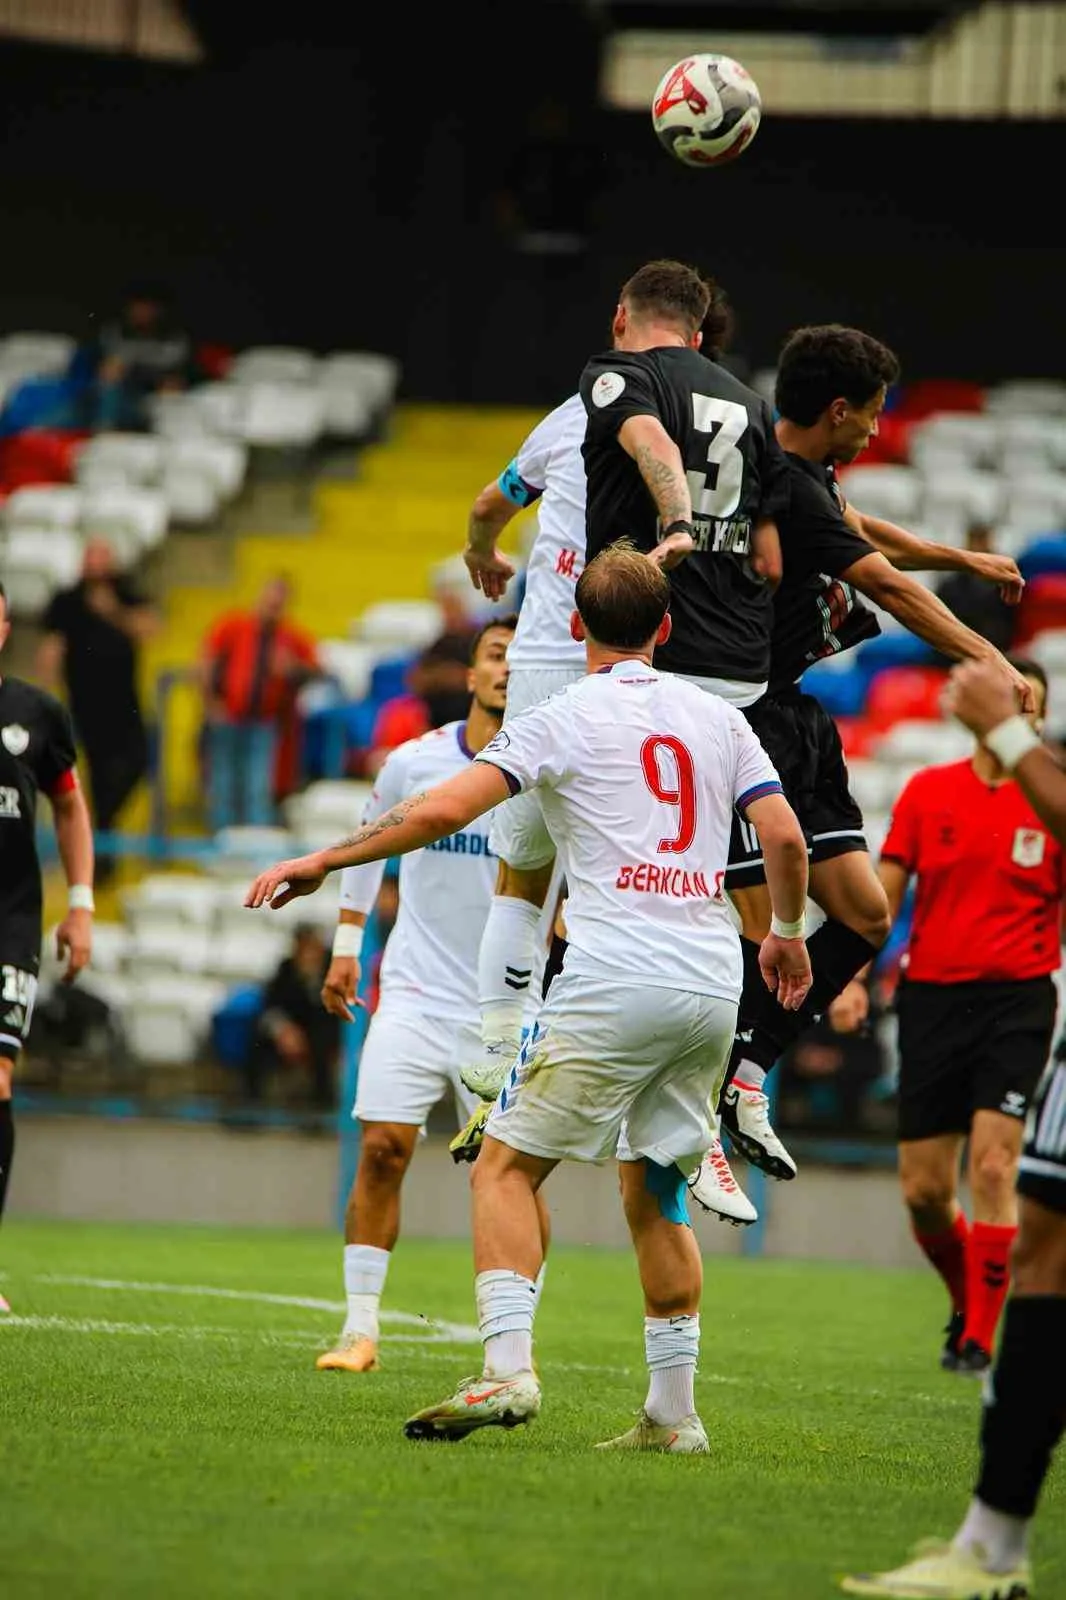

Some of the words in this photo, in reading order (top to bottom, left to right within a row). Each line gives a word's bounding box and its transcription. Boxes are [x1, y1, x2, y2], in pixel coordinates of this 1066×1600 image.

[686, 392, 749, 519] 3
[640, 733, 697, 854] 9
[616, 863, 710, 898] BERKCAN
